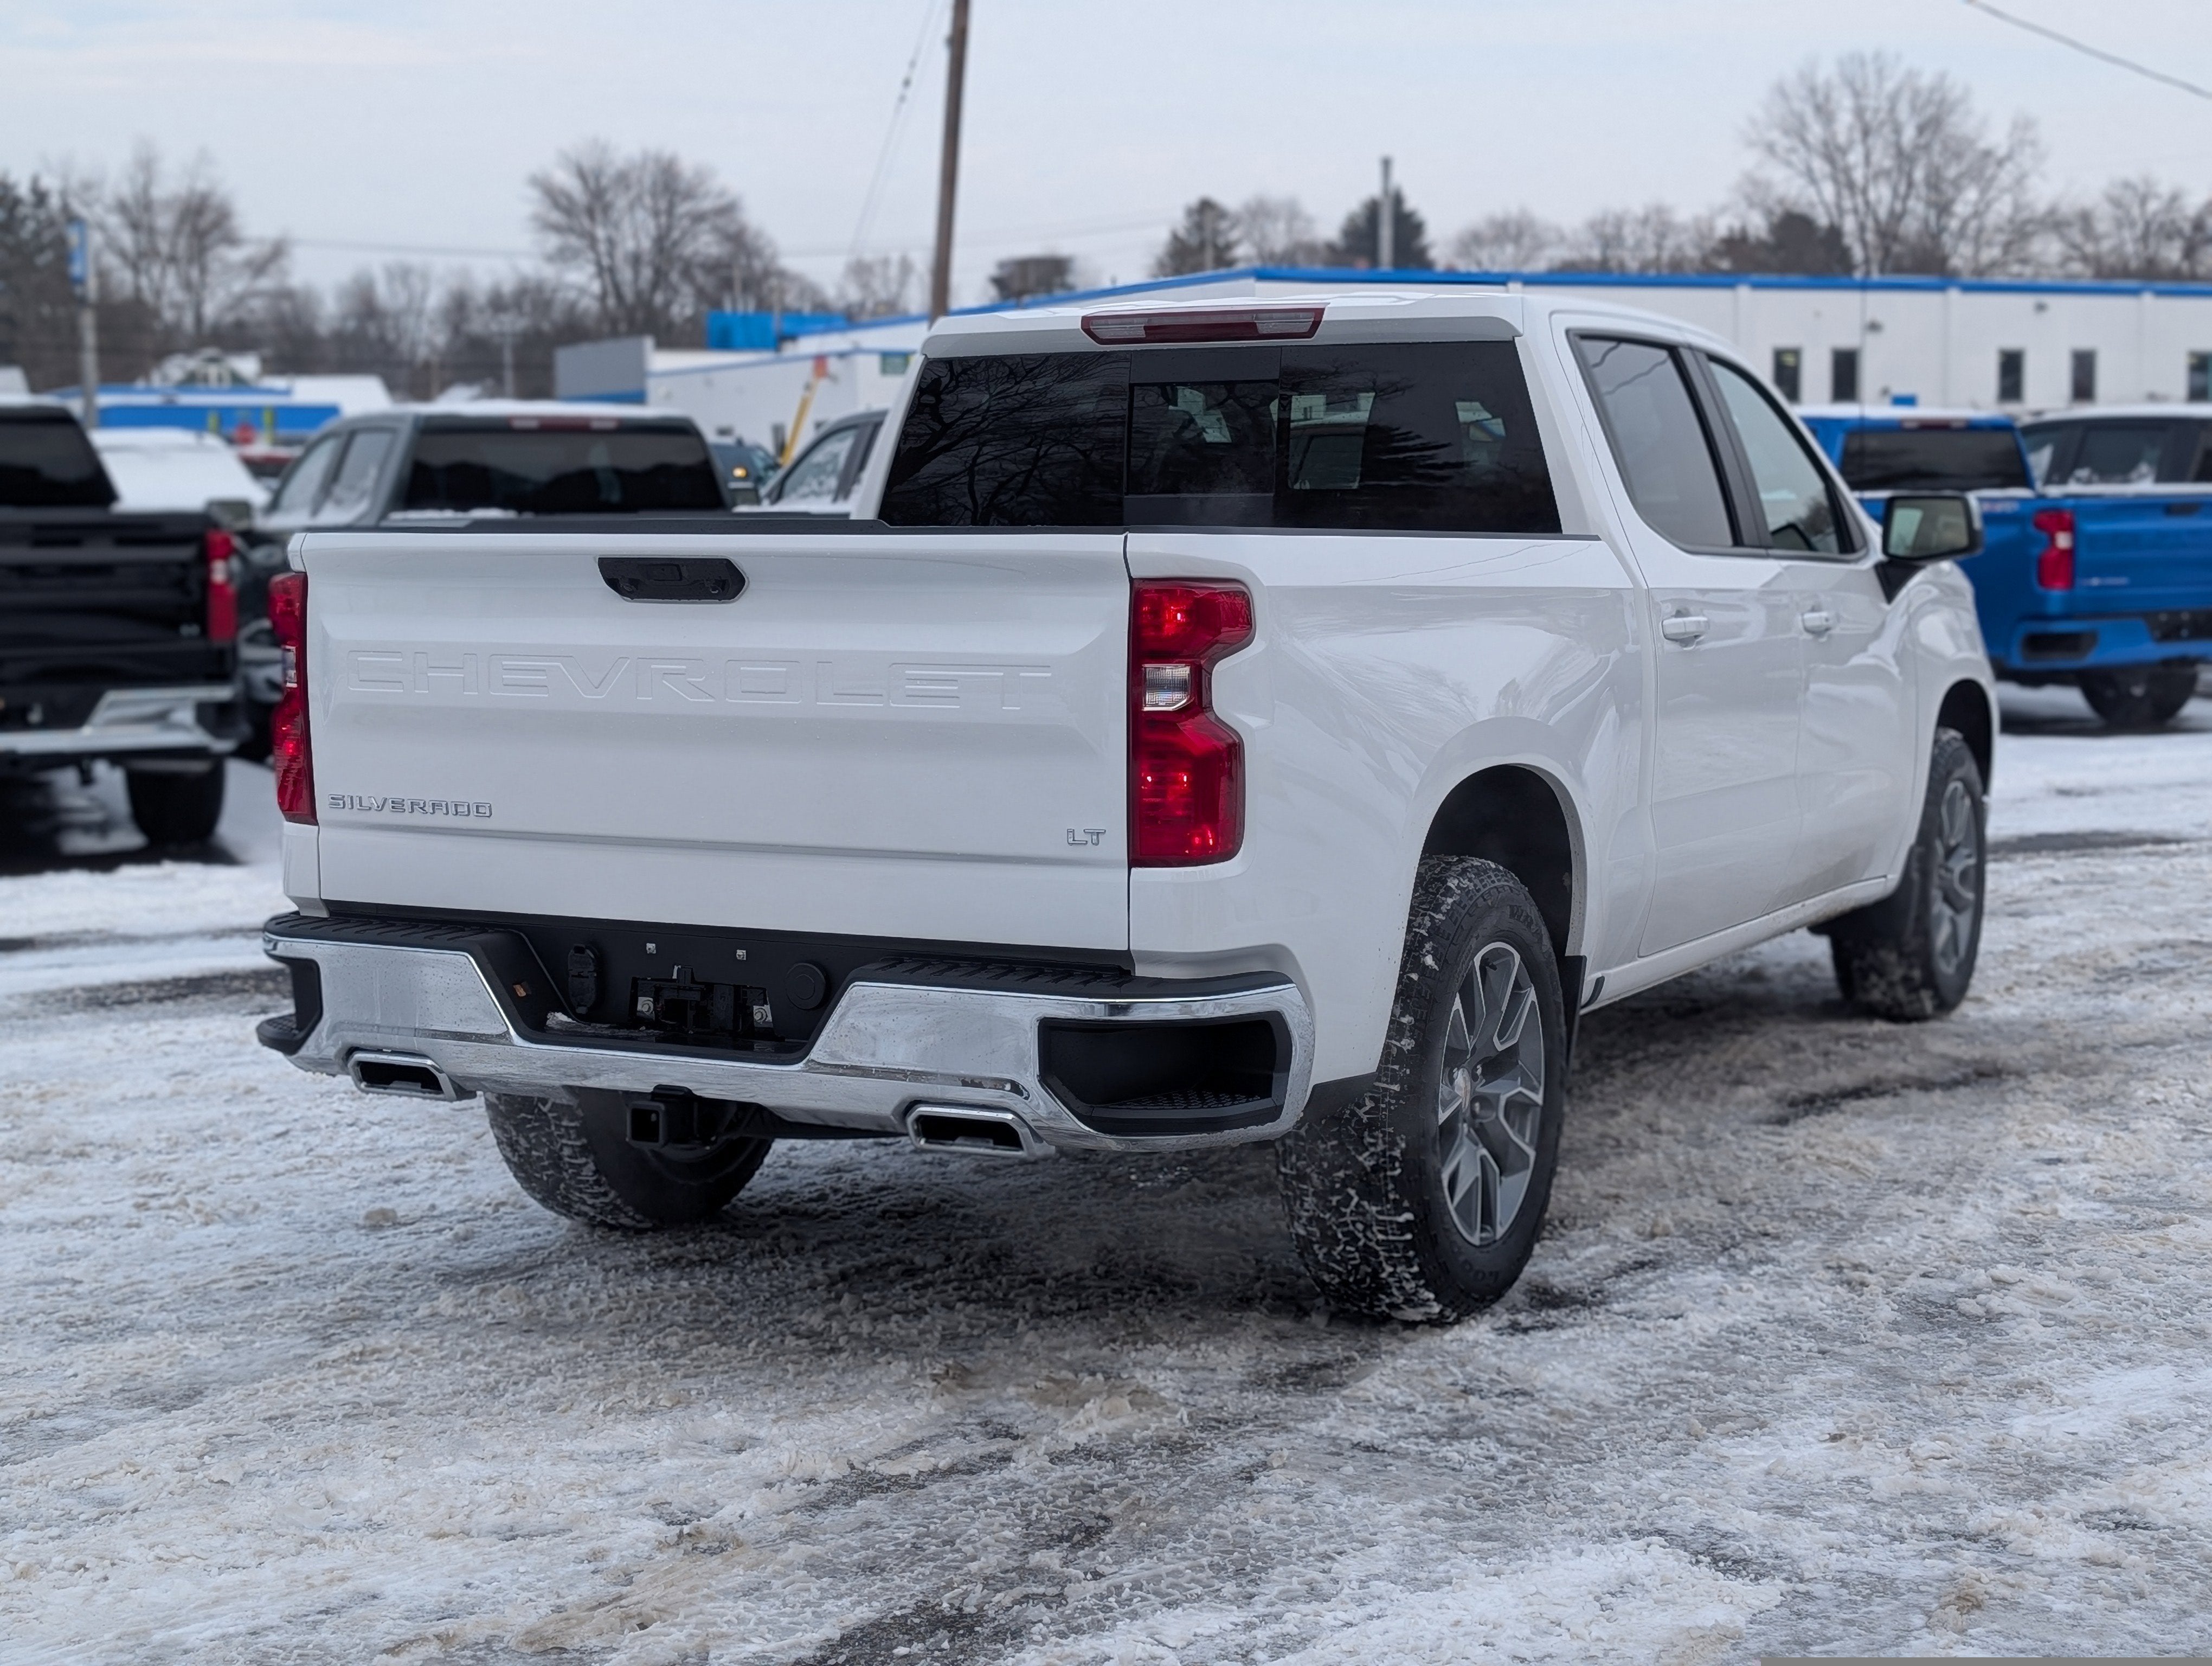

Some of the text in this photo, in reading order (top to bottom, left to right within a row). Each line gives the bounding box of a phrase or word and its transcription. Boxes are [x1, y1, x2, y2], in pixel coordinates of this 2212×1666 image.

[347, 650, 1052, 709] CHEVROLET
[328, 793, 492, 818] SILVERADO
[1067, 828, 1107, 846] LT
